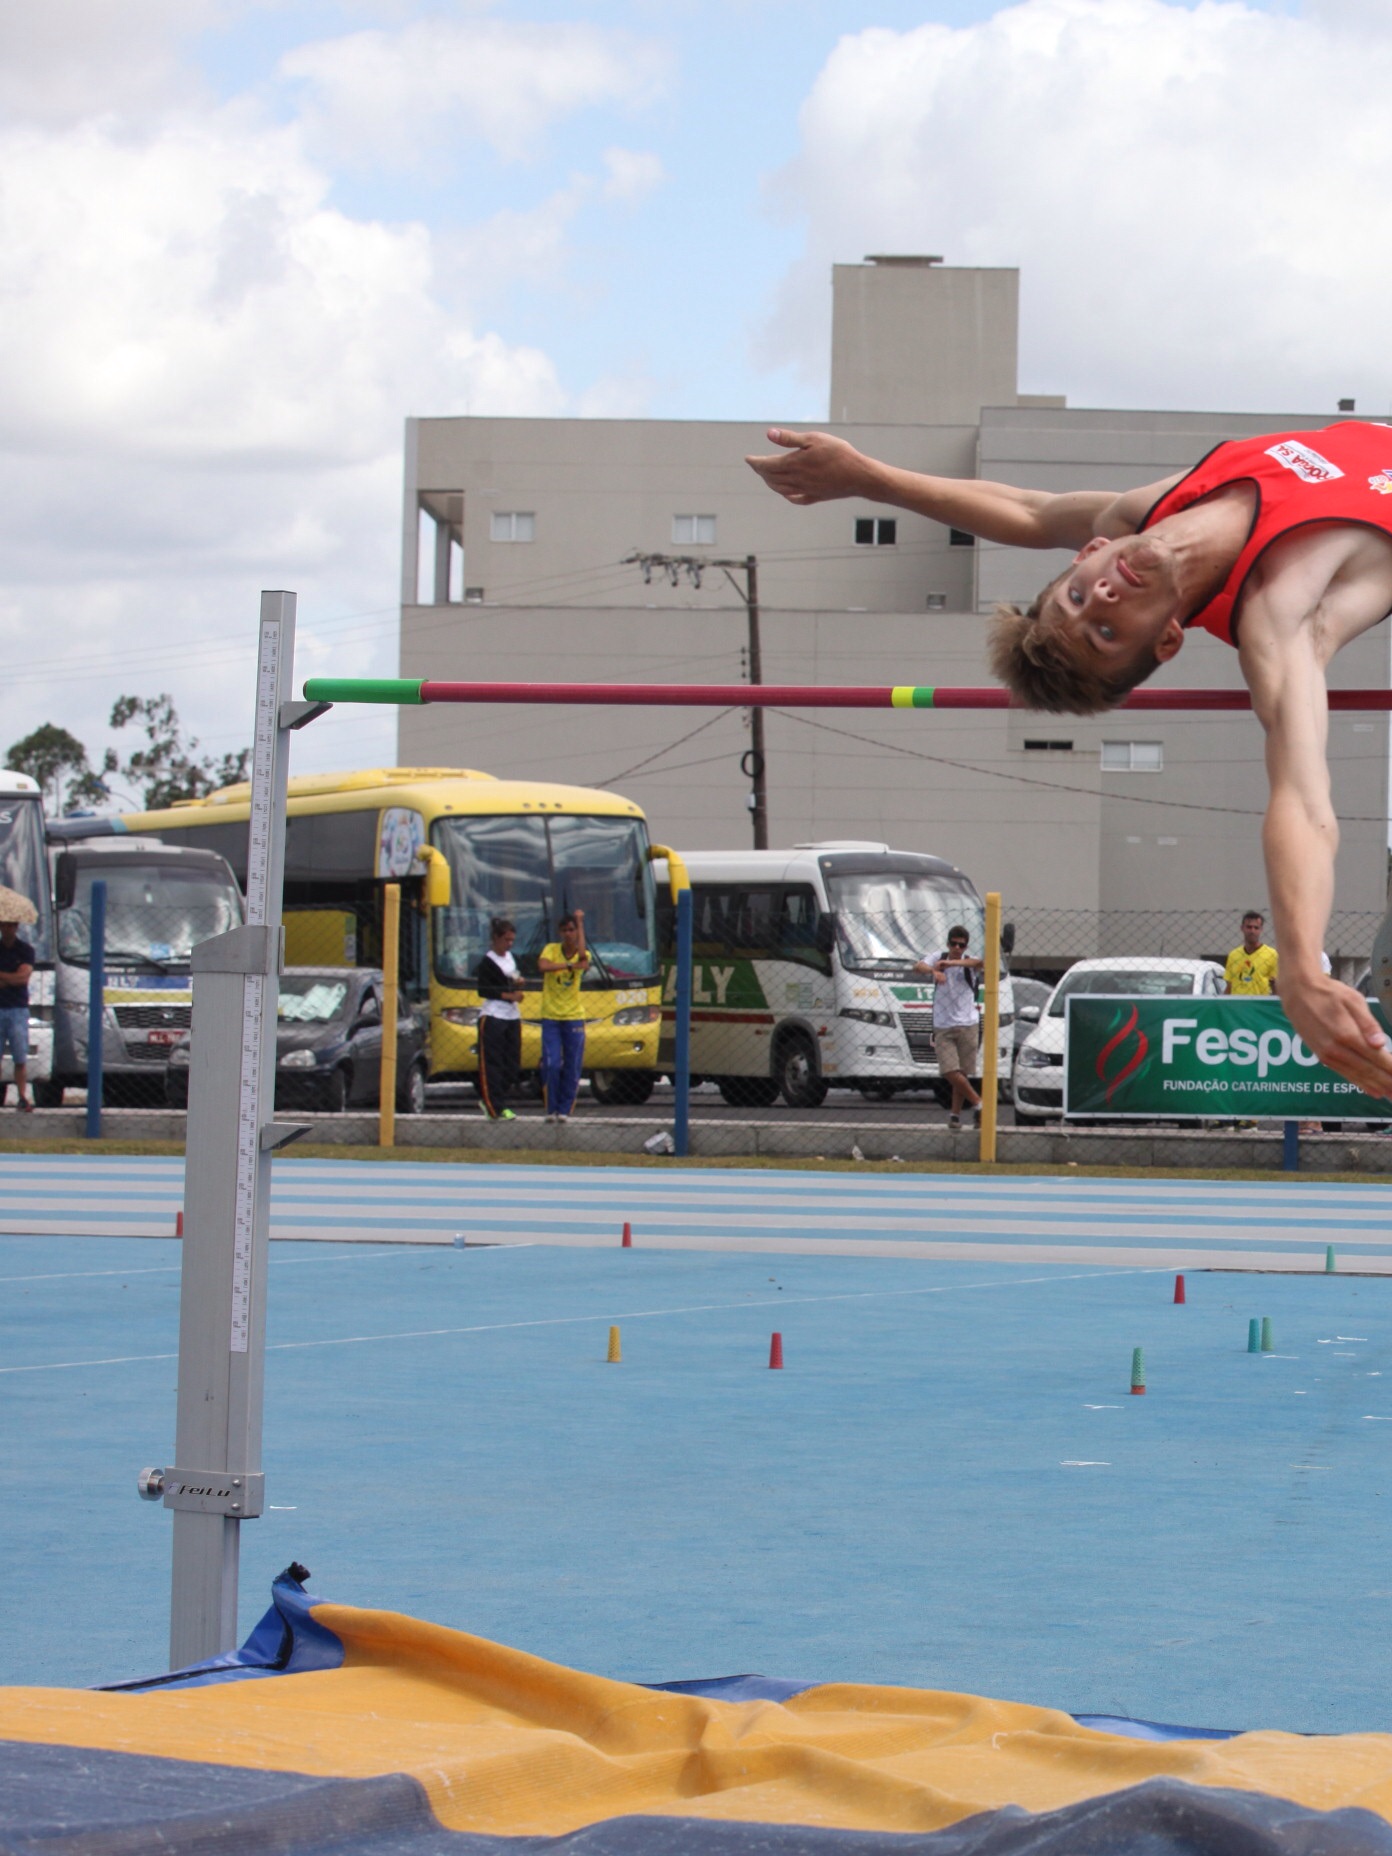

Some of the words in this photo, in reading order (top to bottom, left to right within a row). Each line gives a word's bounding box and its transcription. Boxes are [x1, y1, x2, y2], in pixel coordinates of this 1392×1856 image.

[1163, 1079, 1229, 1093] FUNDAÇÃO
[1232, 1082, 1311, 1093] CATARINENSE
[1314, 1083, 1330, 1093] DE
